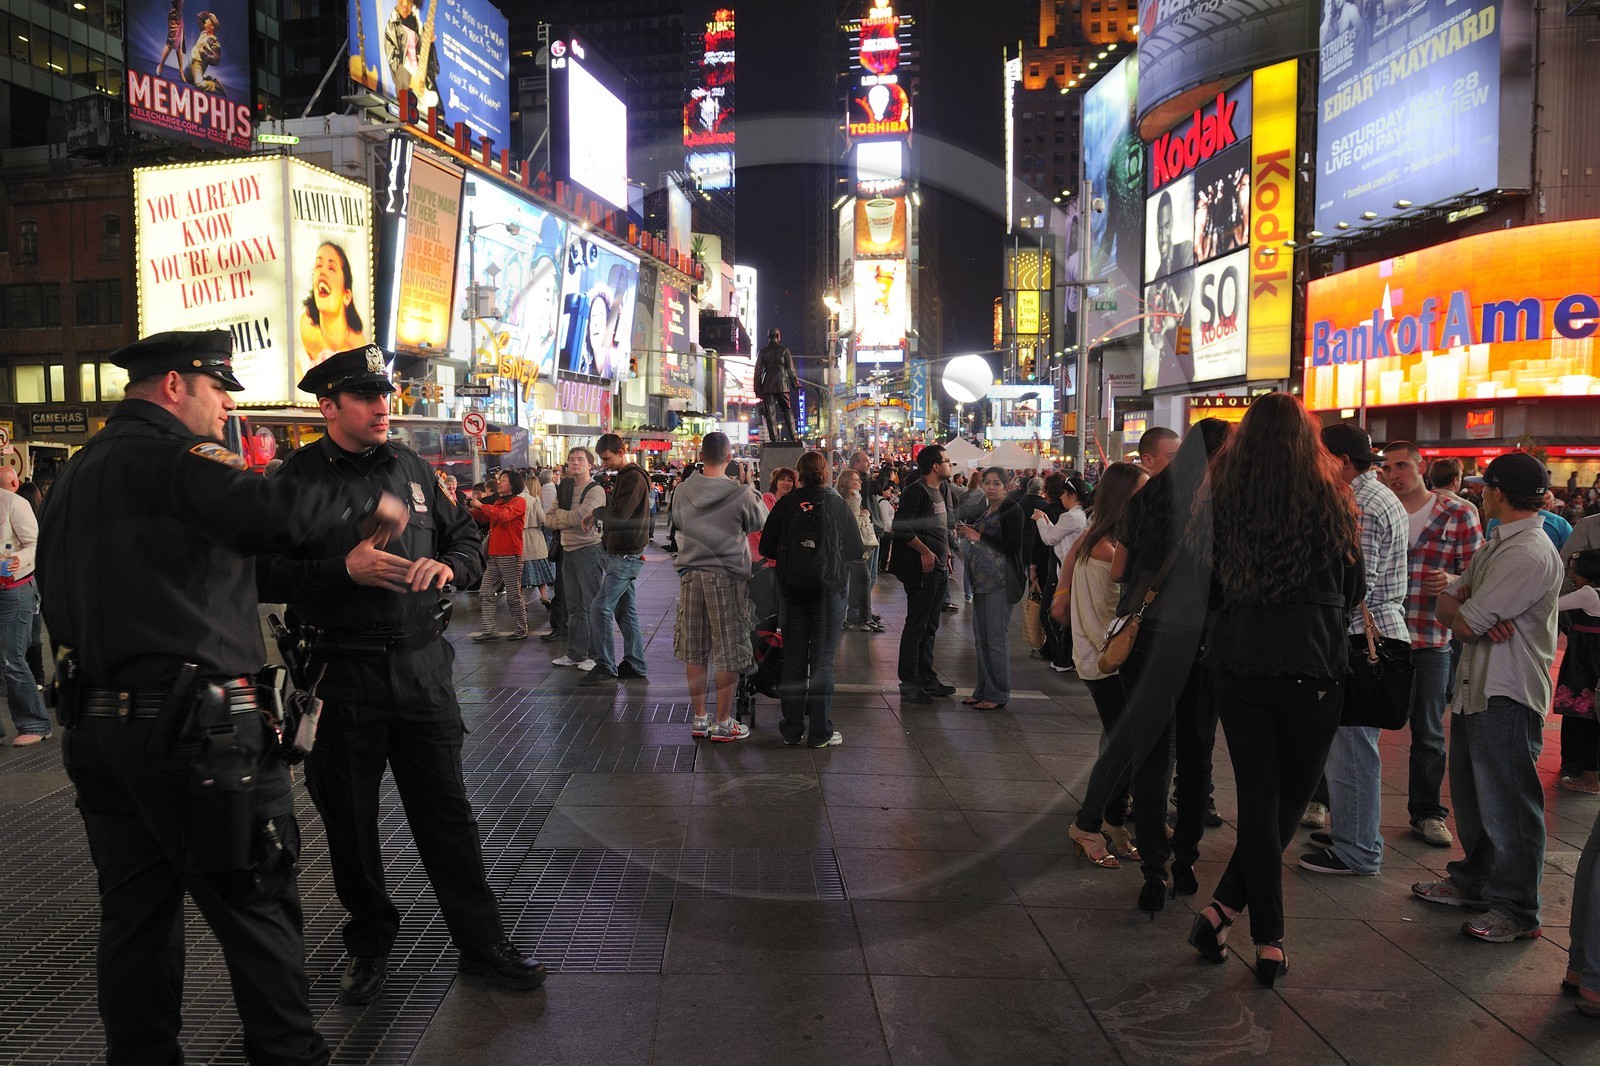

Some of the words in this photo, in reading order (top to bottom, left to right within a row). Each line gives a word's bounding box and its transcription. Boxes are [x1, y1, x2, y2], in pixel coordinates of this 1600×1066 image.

[860, 15, 900, 27] TOSHIBA
[1172, 0, 1221, 26] driving
[1320, 29, 1350, 62] STRUVE
[1322, 41, 1355, 77] BROWNE
[1337, 74, 1359, 92] WORLD
[1360, 45, 1407, 79] LIGHTWEIGHT
[1407, 8, 1472, 50] CHAMPIONSHIP
[1324, 73, 1375, 124] EDGAR
[1374, 66, 1391, 92] VS
[1389, 5, 1496, 87] MAYNARD
[128, 69, 252, 139] MEMPHIS
[132, 107, 199, 131] TELECHARGE.COM
[1331, 104, 1406, 157] SATURDAY
[1409, 84, 1447, 120] MAY
[1452, 71, 1479, 98] 28
[849, 121, 909, 136] TOSHIBA
[1153, 92, 1238, 189] Kodak
[1325, 149, 1352, 176] LIVE
[1353, 138, 1375, 163] ON
[147, 192, 182, 224] YOU
[186, 173, 261, 217] ALREADY
[292, 188, 339, 224] MAMMA
[339, 195, 364, 227] MIA!
[409, 200, 418, 218] IT
[418, 203, 438, 225] HERE.
[411, 183, 438, 209] YOU'VE
[438, 193, 457, 217] MADE
[181, 211, 233, 247] KNOW
[408, 218, 424, 237] BUT
[424, 222, 442, 244] WILL
[1253, 149, 1291, 300] Kodak
[150, 248, 214, 284] YOU'RE
[217, 235, 277, 272] GONNA
[406, 251, 416, 269] TO
[417, 256, 442, 278] RETIRE
[407, 234, 423, 254] YOU
[423, 240, 433, 257] BE
[433, 243, 451, 263] ABLE
[180, 276, 226, 309] LOVE
[229, 269, 255, 300] IT!
[404, 269, 447, 295] ANYWHERE?
[1200, 265, 1240, 333] SO
[1020, 307, 1036, 316] LION
[1020, 317, 1037, 327] KING
[1201, 311, 1238, 346] Kodak
[229, 317, 272, 354] MIA!
[1311, 308, 1395, 367] Bank
[1397, 296, 1442, 356] of
[1107, 373, 1136, 381] Marriott
[554, 379, 603, 413] FOREVER
[32, 412, 82, 423] CAMERAS
